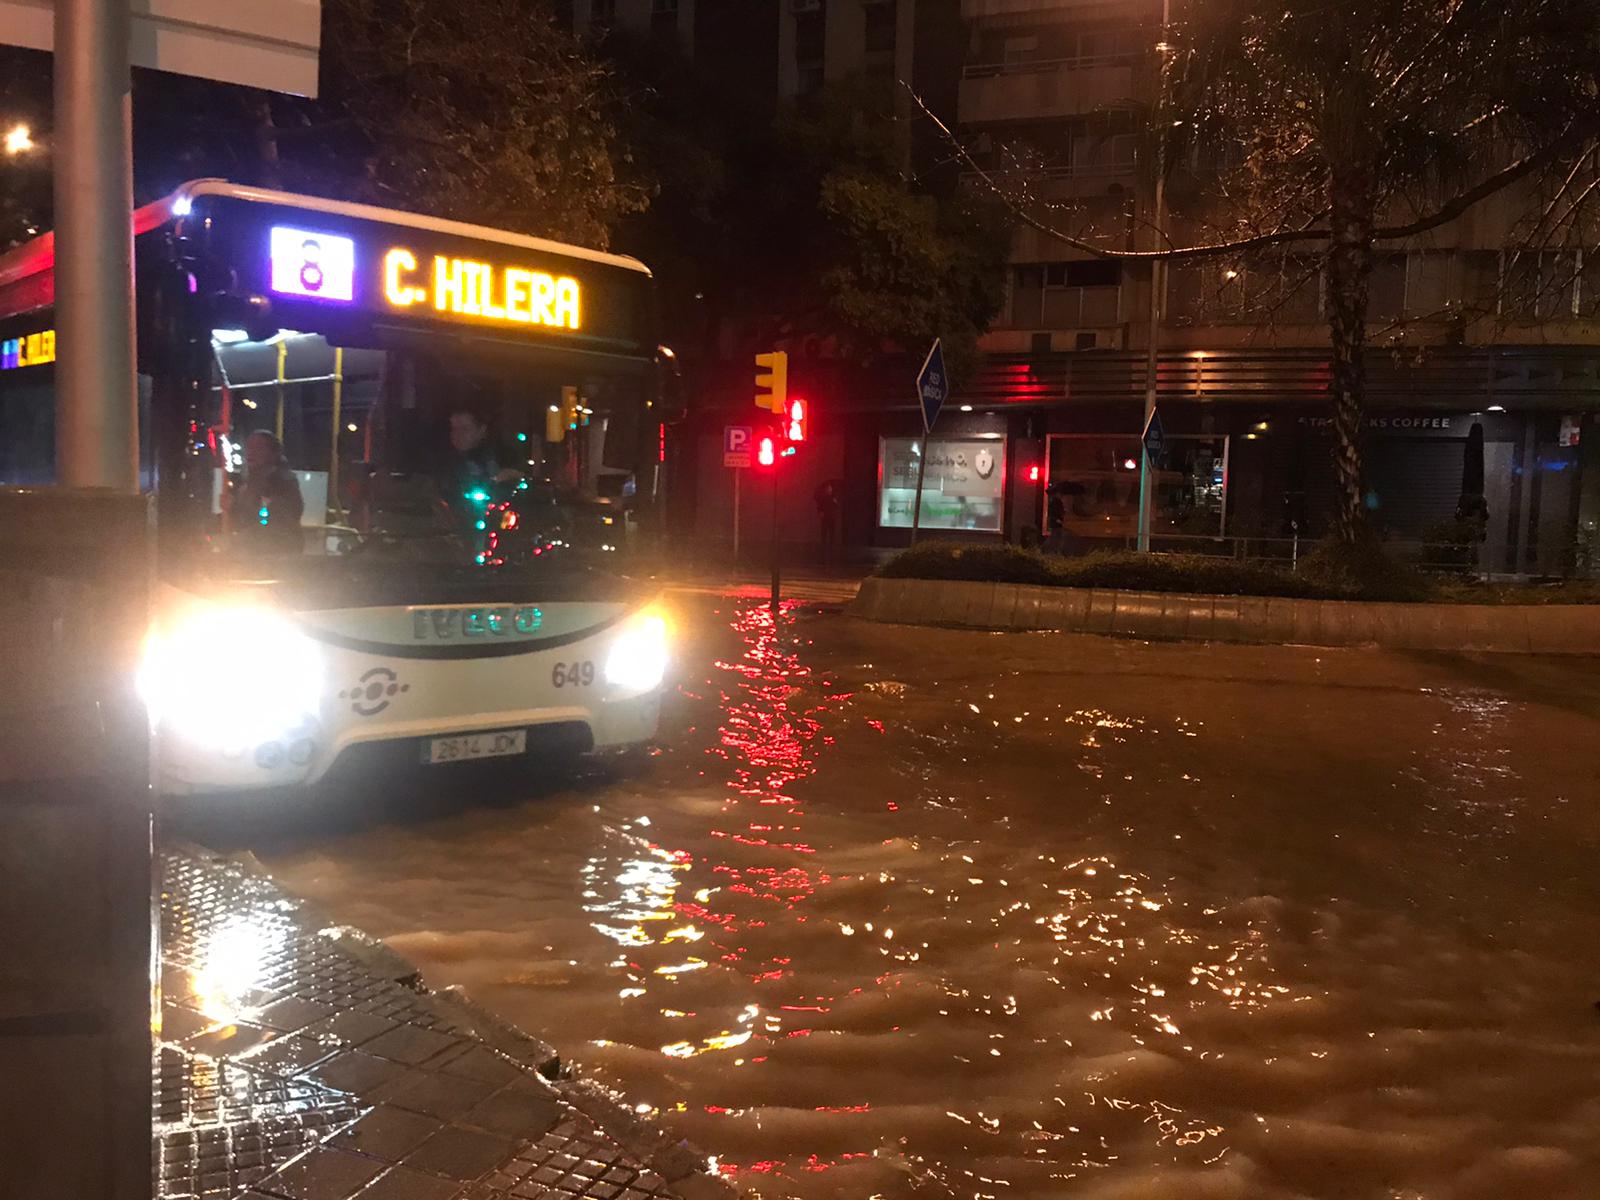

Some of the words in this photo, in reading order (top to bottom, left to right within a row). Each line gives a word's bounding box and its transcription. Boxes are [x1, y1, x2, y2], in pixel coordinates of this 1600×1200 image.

[299, 238, 324, 292] 8
[433, 255, 581, 330] HILERA
[1391, 417, 1451, 429] COFFEE
[730, 429, 746, 451] P
[414, 608, 543, 639] IVECO
[553, 661, 595, 688] 649
